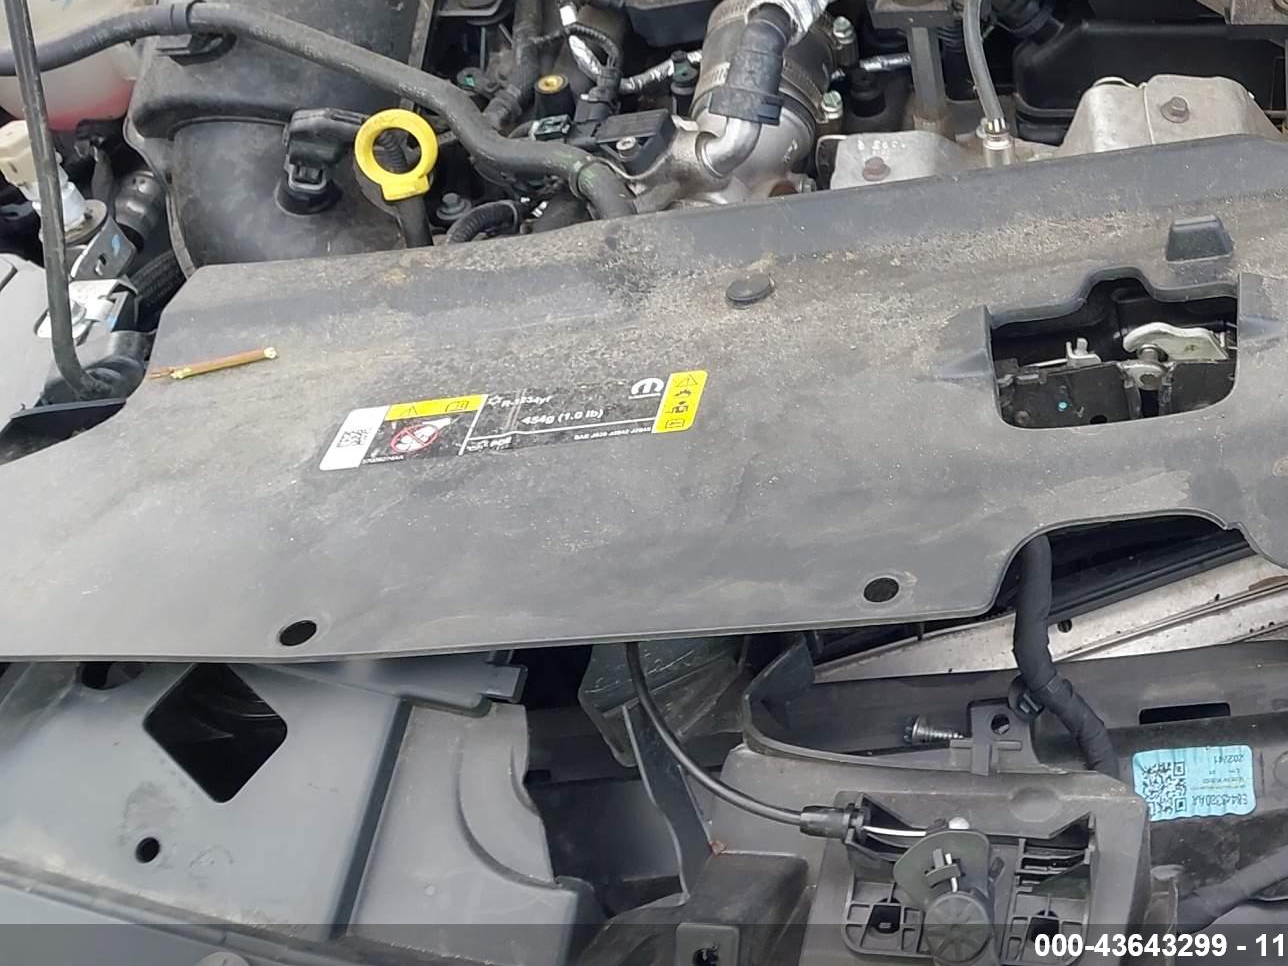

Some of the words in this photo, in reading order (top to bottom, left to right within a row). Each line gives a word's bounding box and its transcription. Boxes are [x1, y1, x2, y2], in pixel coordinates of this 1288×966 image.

[522, 414, 556, 426] 454g
[557, 410, 583, 424] (1.0
[585, 408, 604, 421] lb)
